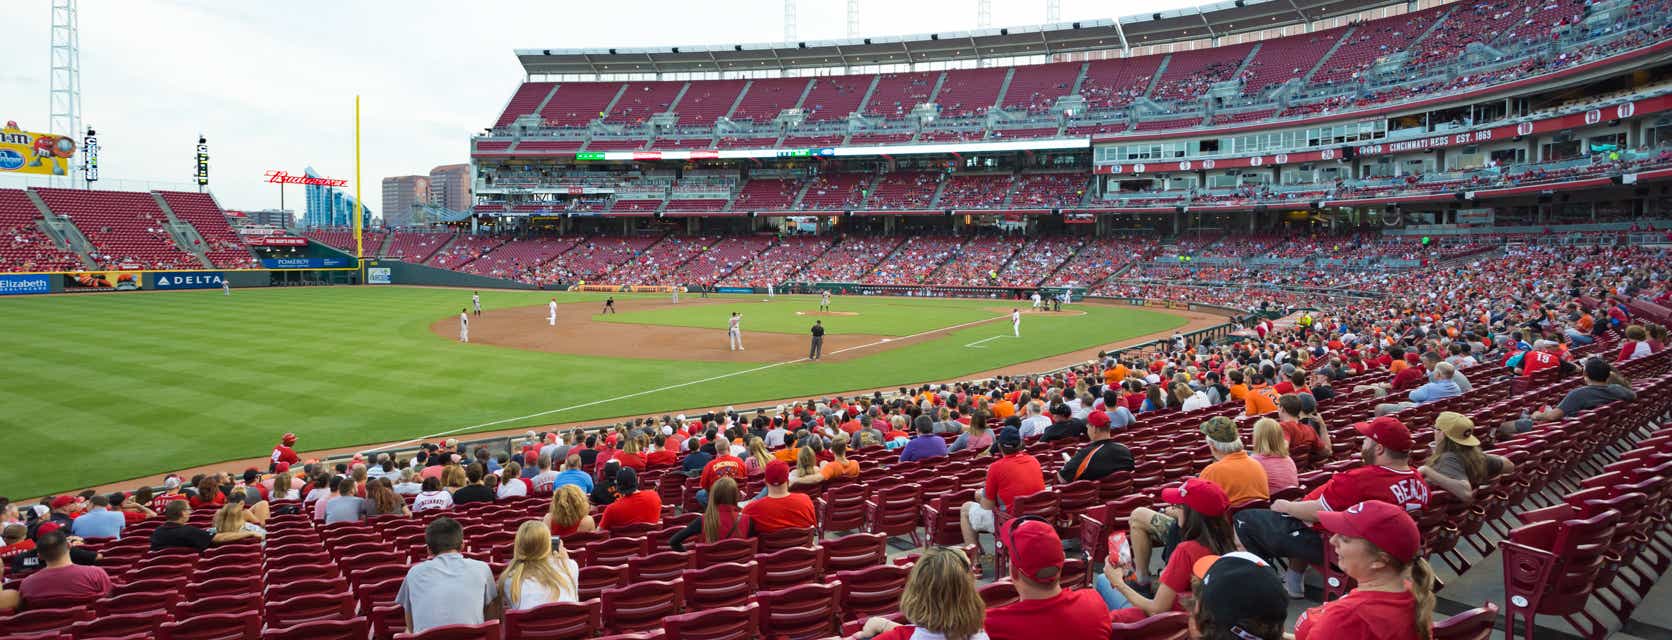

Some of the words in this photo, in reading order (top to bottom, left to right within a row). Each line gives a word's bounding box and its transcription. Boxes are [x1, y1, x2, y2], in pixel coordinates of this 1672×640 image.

[1389, 140, 1428, 152] CINCINNATI
[1430, 136, 1449, 147] REDS
[1456, 132, 1473, 144] EST.
[1475, 130, 1492, 141] 1869
[264, 170, 348, 186] Budweiser
[0, 279, 47, 289] Elizabeth
[174, 275, 221, 285] DELTA
